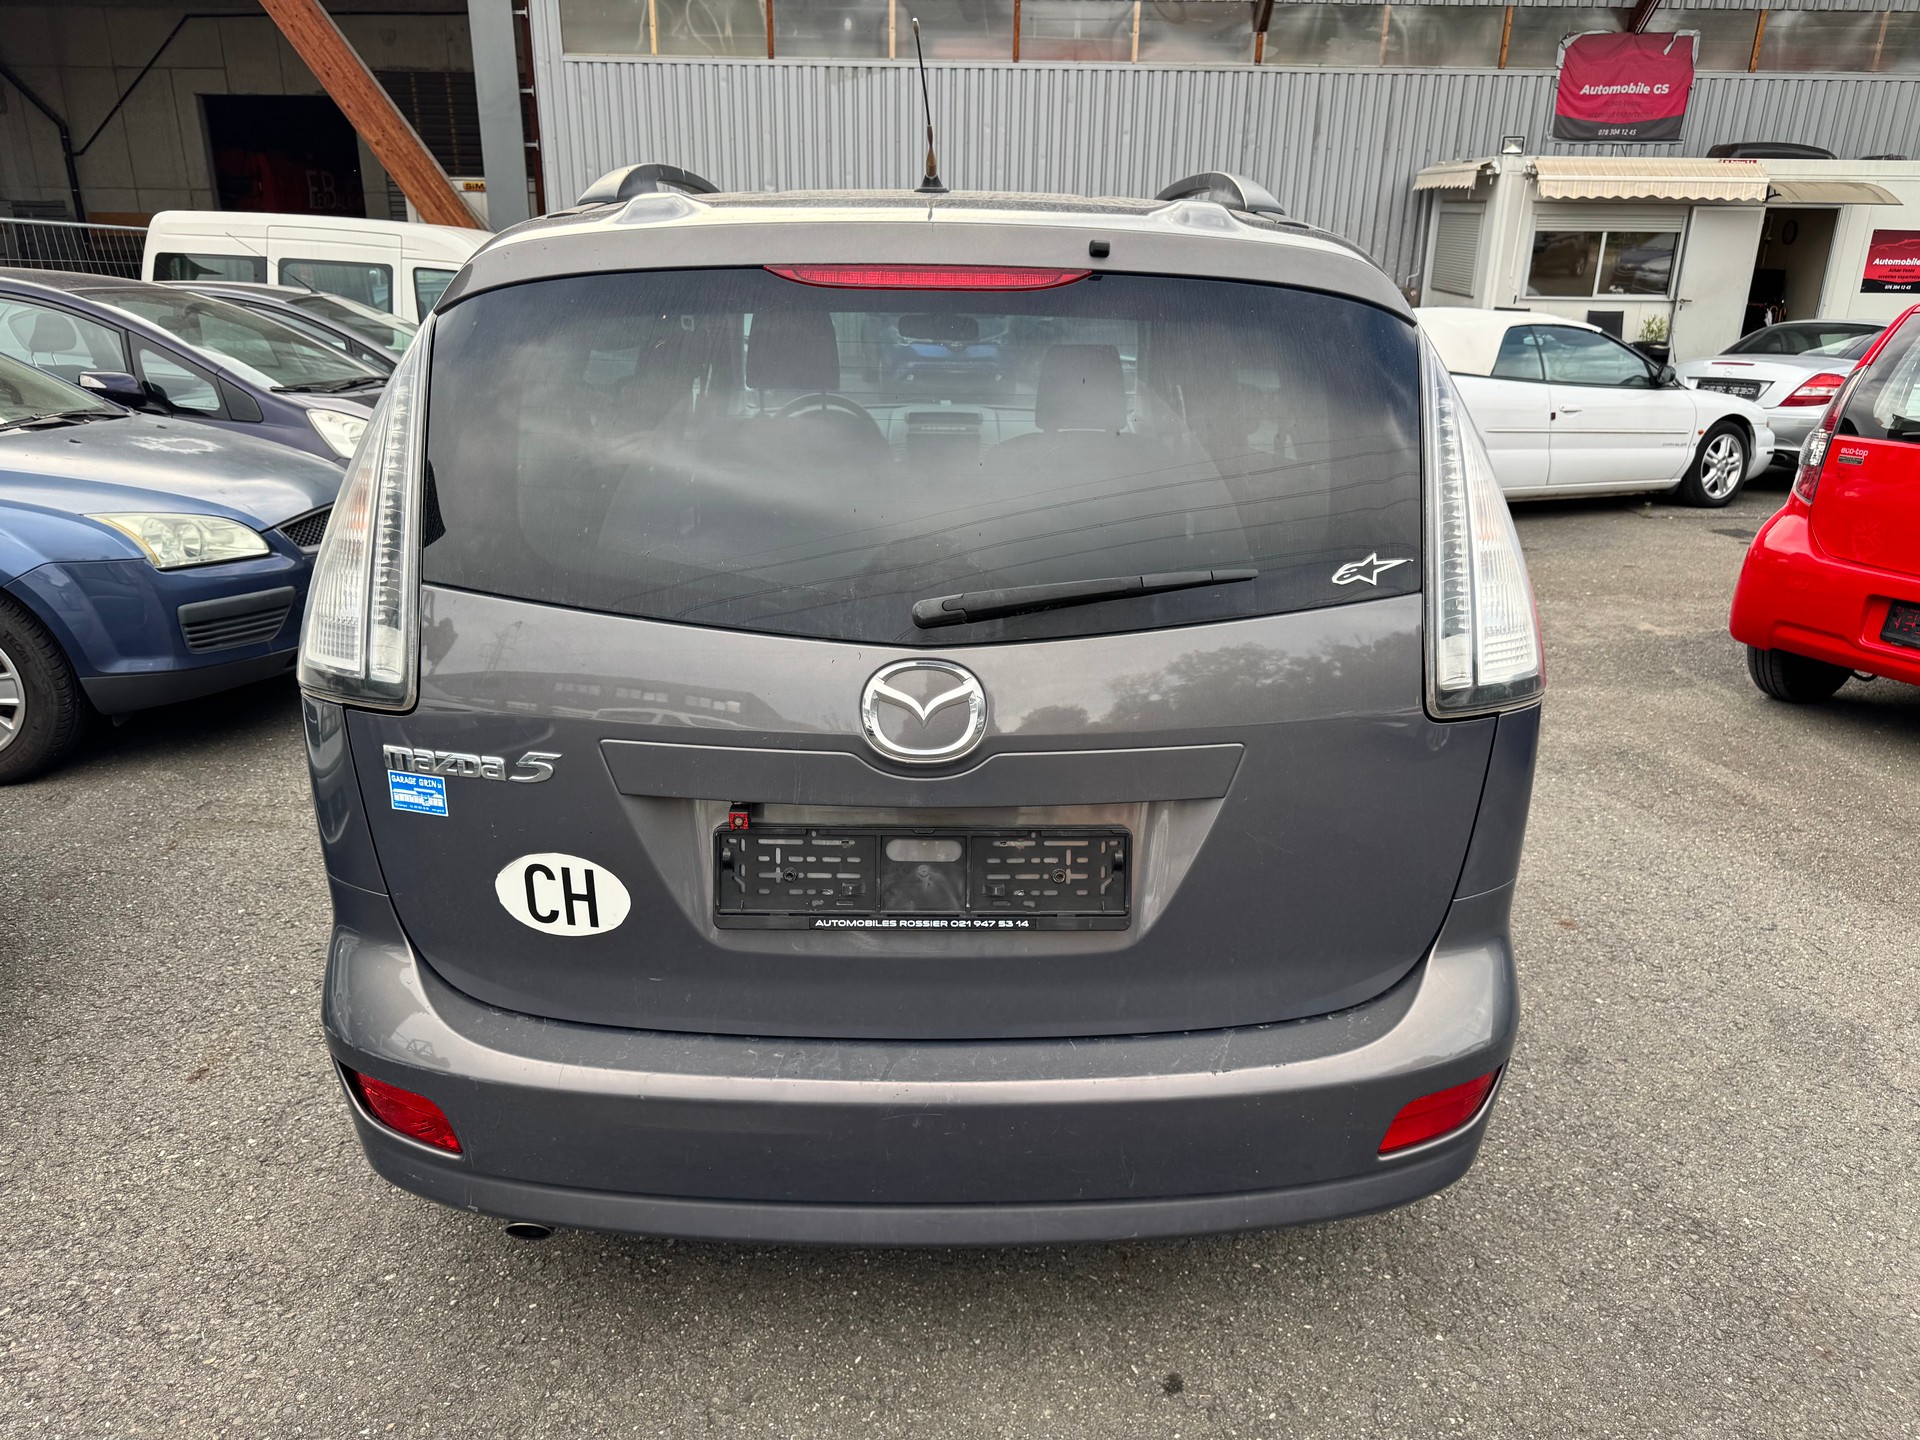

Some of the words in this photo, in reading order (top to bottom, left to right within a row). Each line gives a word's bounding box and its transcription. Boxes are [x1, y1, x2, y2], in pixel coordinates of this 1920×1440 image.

[1579, 82, 1650, 95] Automobile
[1653, 83, 1669, 95] GS
[1598, 128, 1609, 136] 078
[1609, 128, 1621, 136] 304
[1873, 257, 1920, 266] Automobile
[508, 751, 563, 783] 5
[391, 774, 417, 786] GARAGE
[418, 778, 437, 789] GRIN
[524, 863, 599, 928] CH
[815, 919, 897, 928] AUTOMOBILES
[899, 919, 949, 928] ROSSIER
[950, 920, 972, 928] 021
[973, 920, 996, 928] 947
[998, 920, 1014, 928] 53
[1015, 920, 1030, 928] 14
